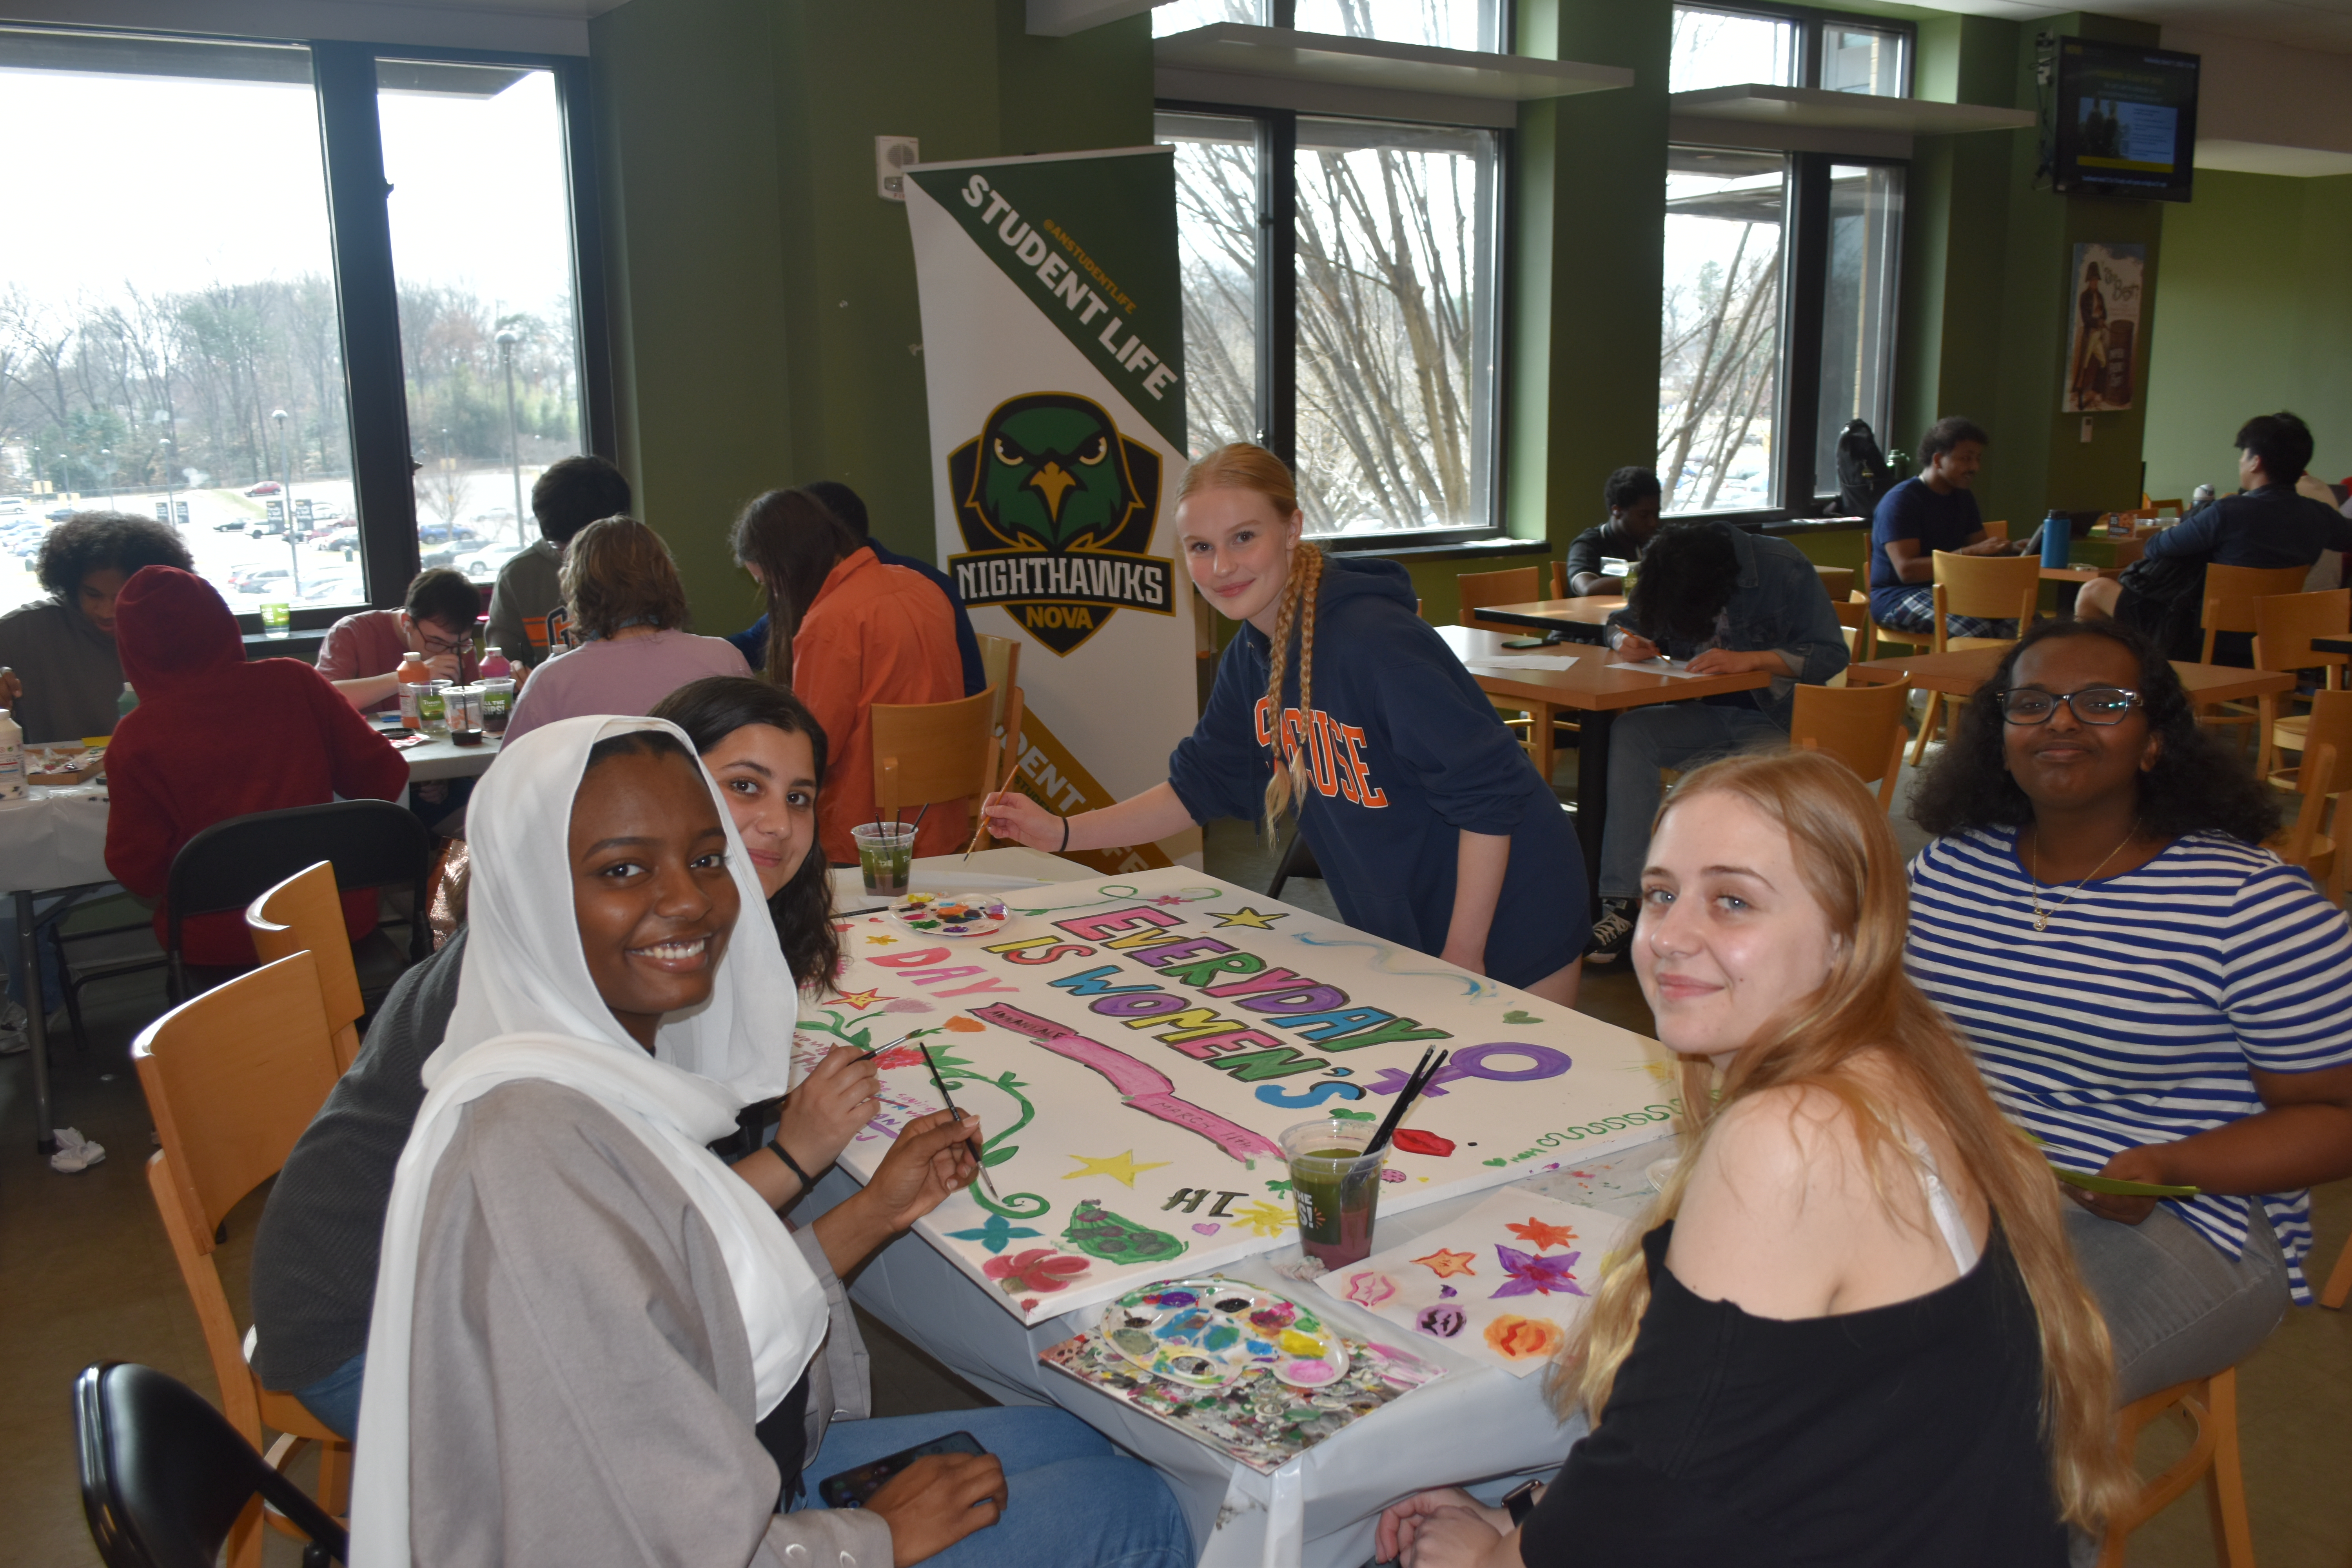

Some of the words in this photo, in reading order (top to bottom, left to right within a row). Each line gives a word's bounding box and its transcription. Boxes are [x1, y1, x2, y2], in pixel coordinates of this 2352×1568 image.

[961, 174, 1109, 325] STUDENT
[1098, 317, 1178, 401] LIFE
[1043, 218, 1136, 314] @ANSTUDENTLIFE
[956, 557, 1163, 604] NIGHTHAWKS
[1026, 606, 1093, 629] NOVA
[865, 947, 1020, 997] DAY
[1050, 905, 1454, 1053] EVERYDAY
[981, 935, 1098, 965] IS
[1046, 965, 1367, 1109] WOMEN'S
[1150, 1102, 1216, 1129] MARCH
[1160, 1188, 1249, 1217] HI
